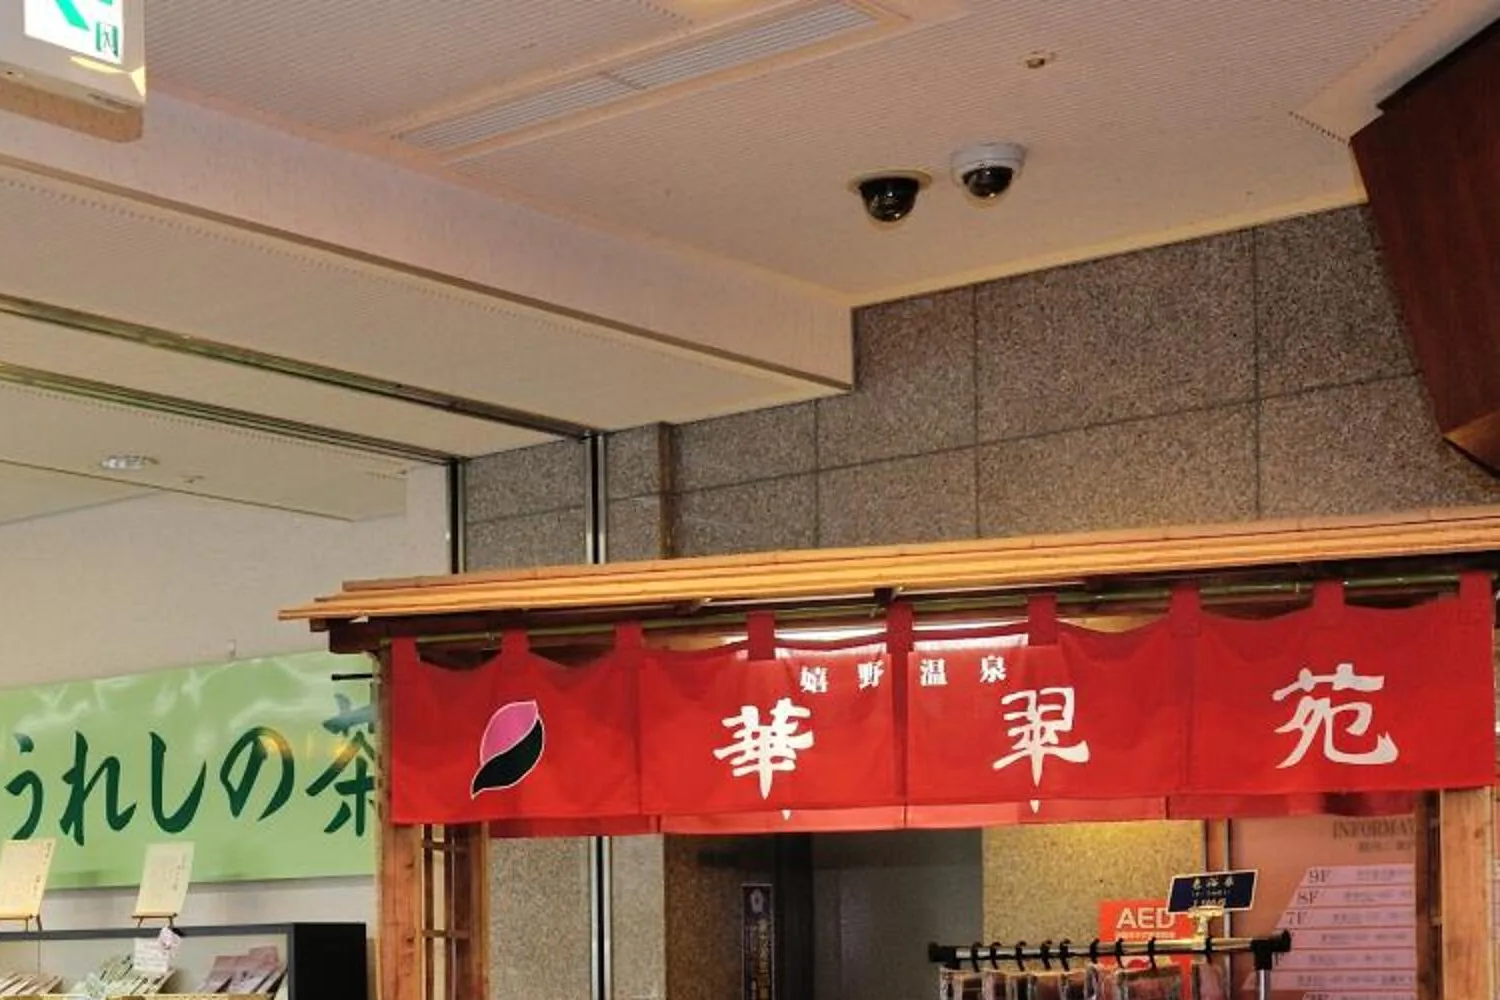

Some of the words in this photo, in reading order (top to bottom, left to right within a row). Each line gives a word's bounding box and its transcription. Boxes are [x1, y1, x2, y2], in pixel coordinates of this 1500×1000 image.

[799, 654, 1008, 695] 嬉野温泉
[4, 692, 376, 847] うれしの茶
[711, 662, 1401, 806] 華翠苑
[1115, 906, 1177, 930] AED
